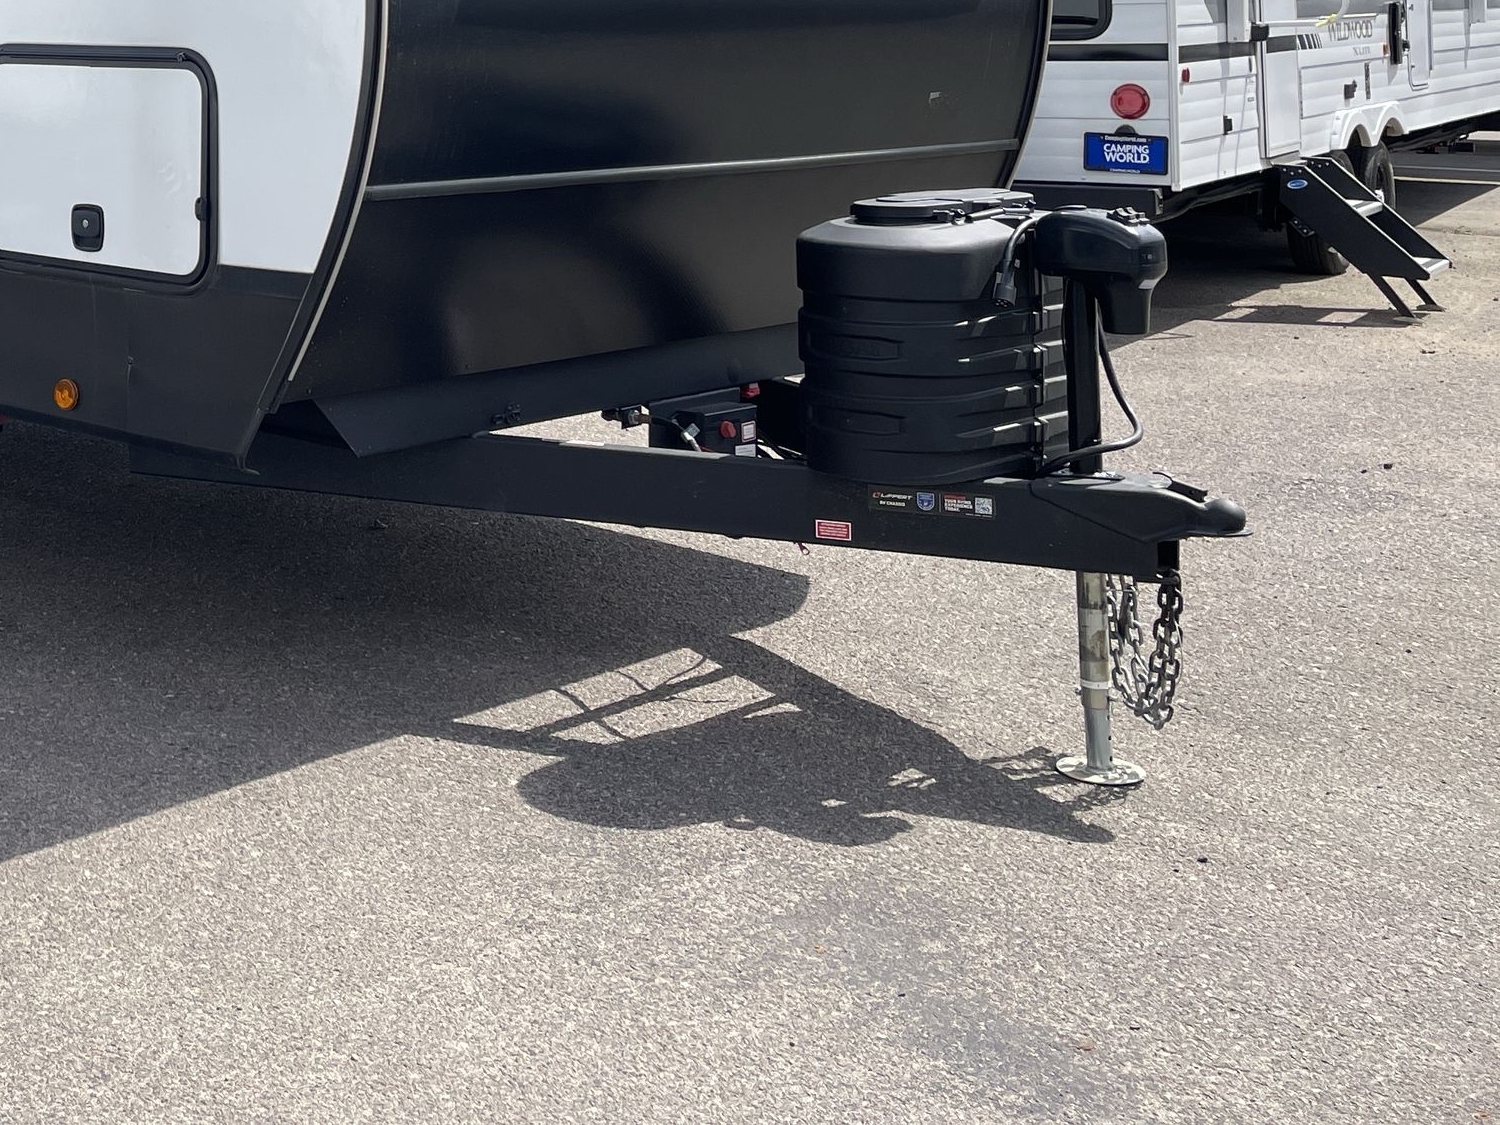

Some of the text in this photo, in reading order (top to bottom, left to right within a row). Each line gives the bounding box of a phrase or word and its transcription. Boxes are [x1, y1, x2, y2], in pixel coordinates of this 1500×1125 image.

[1328, 20, 1373, 42] WILDWOOD
[1103, 143, 1150, 154] CAMPING
[1103, 152, 1150, 164] WORLD
